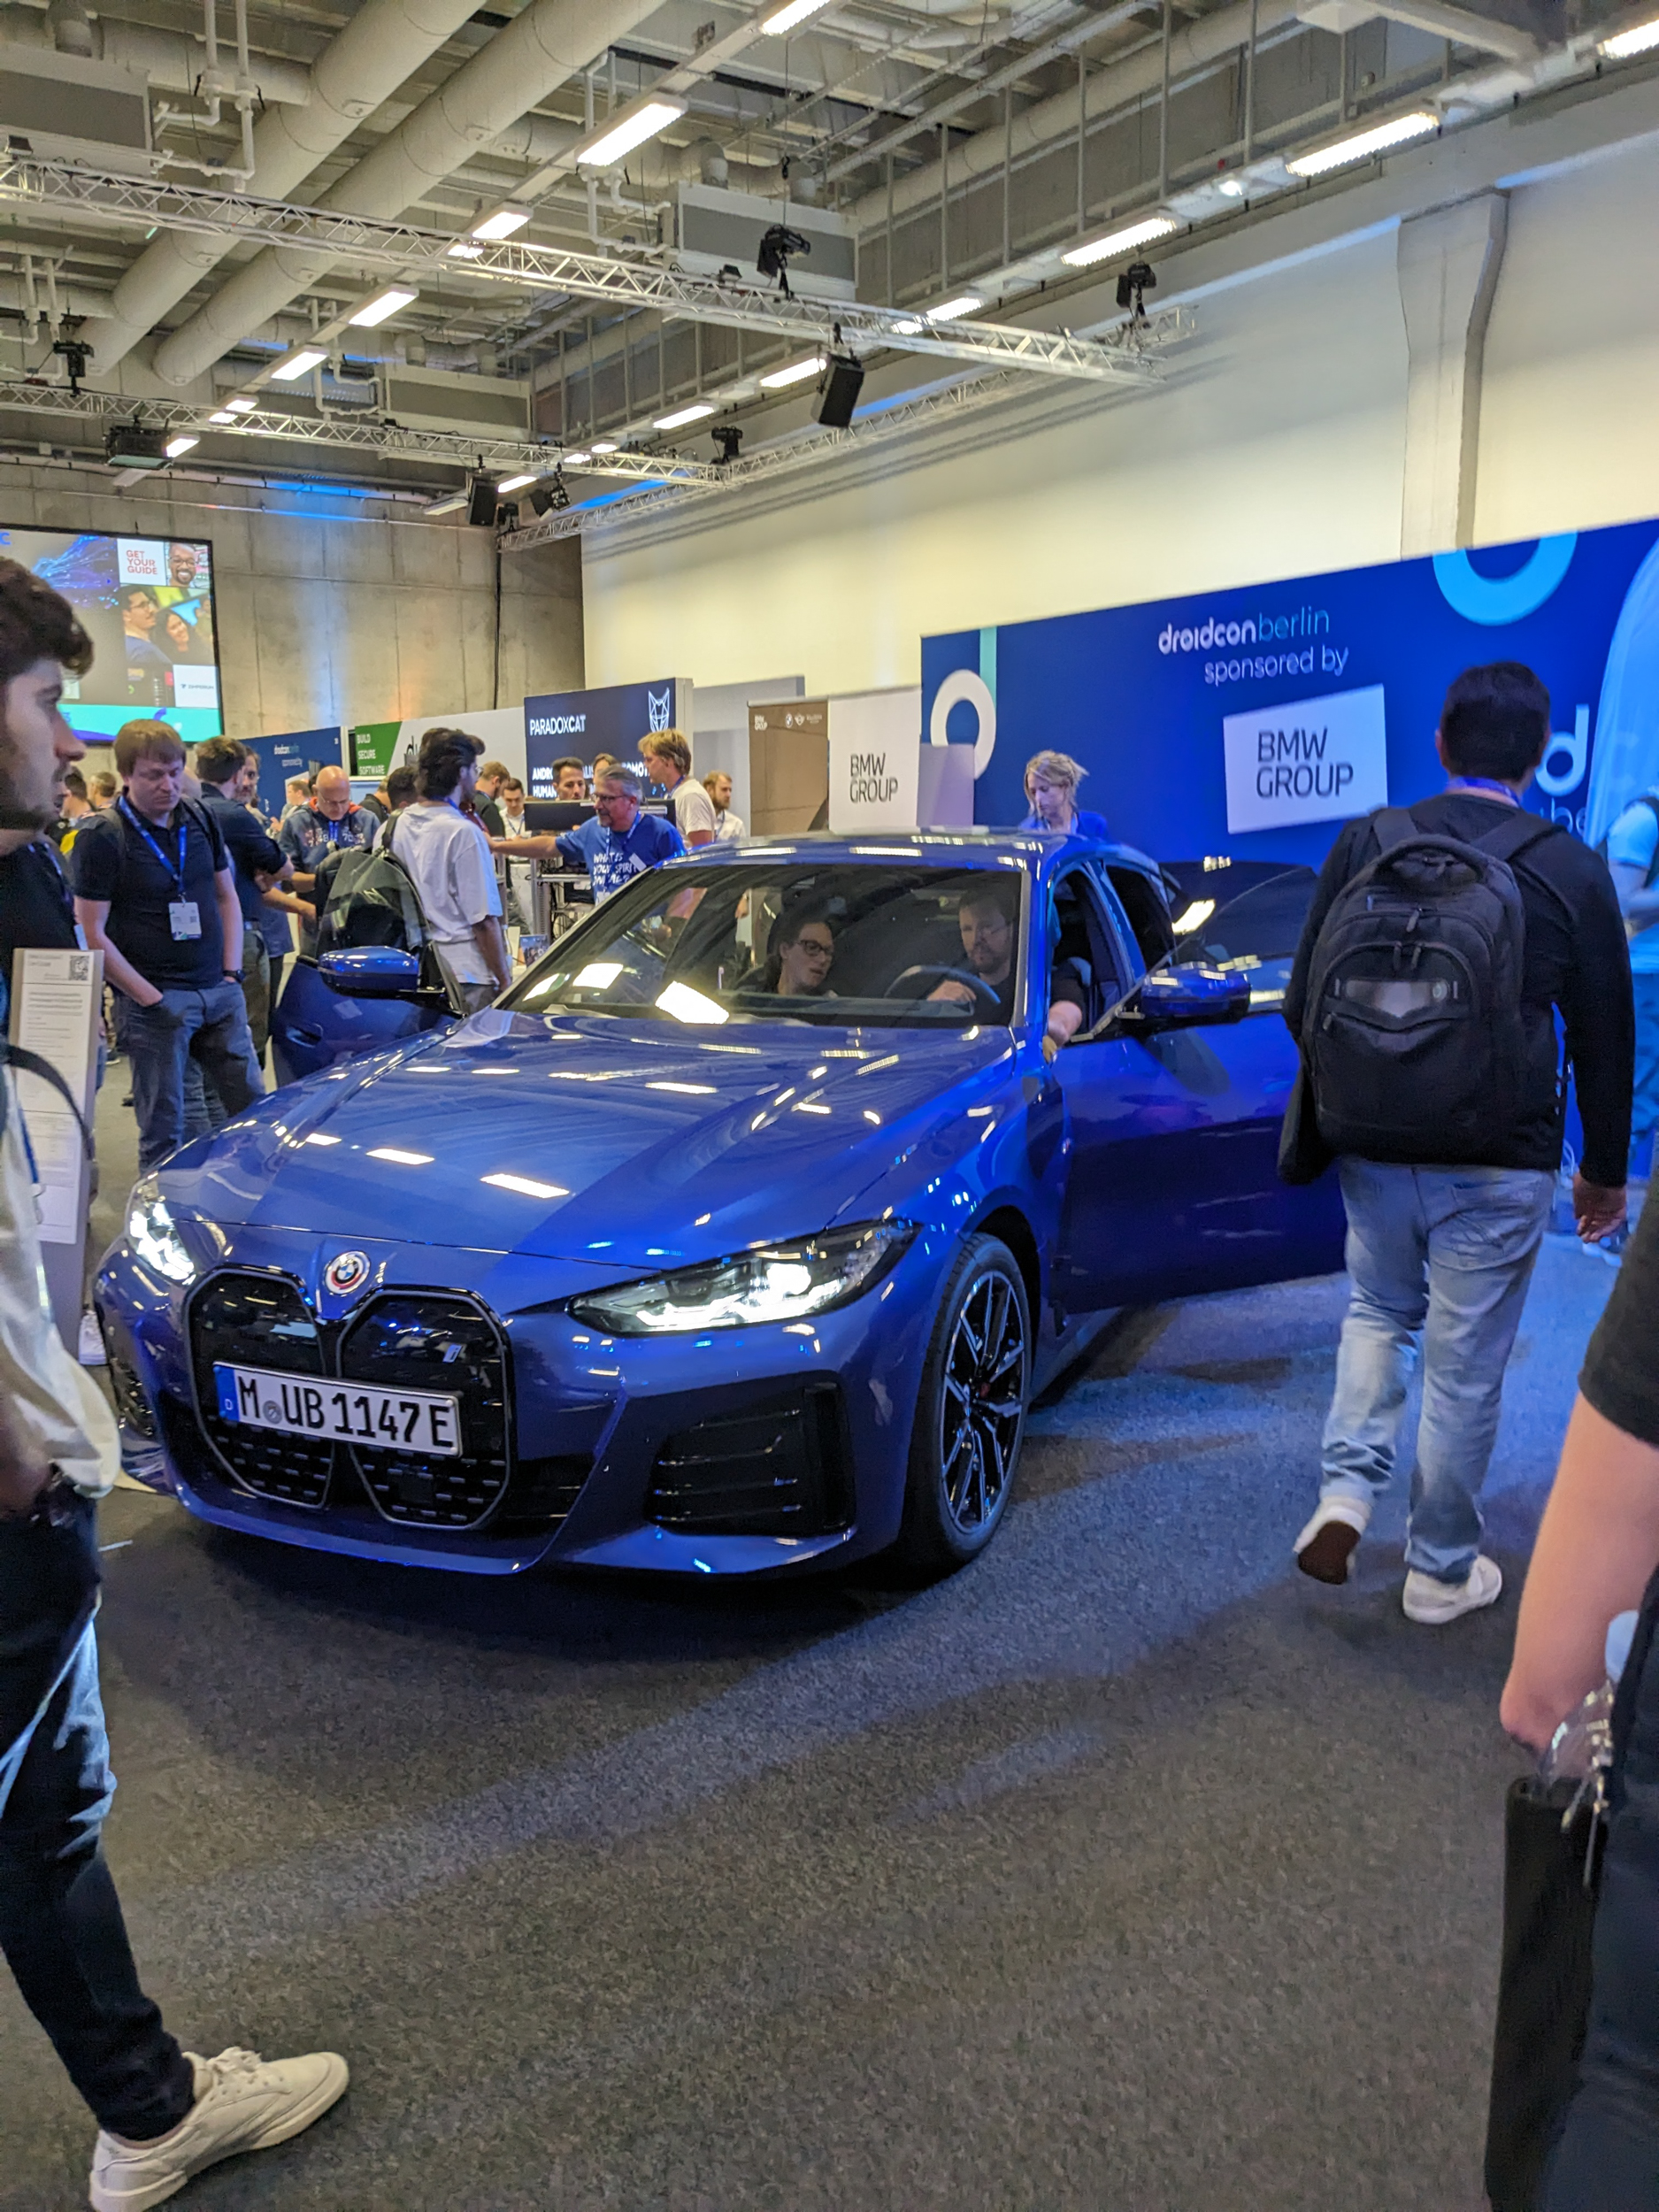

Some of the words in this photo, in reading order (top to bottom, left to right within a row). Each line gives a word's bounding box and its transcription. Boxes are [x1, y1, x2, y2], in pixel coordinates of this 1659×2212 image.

[127, 549, 145, 558] GET
[127, 557, 156, 566] YOUR
[127, 565, 157, 575] GUIDE
[1204, 646, 1314, 687] sponsored
[1322, 644, 1349, 677] by
[529, 714, 587, 736] PARADOXCAT
[1257, 726, 1328, 763] BMW
[850, 752, 887, 778] BMW
[849, 777, 898, 803] GROUP
[1256, 763, 1354, 799] GROUP
[237, 1376, 261, 1419] M
